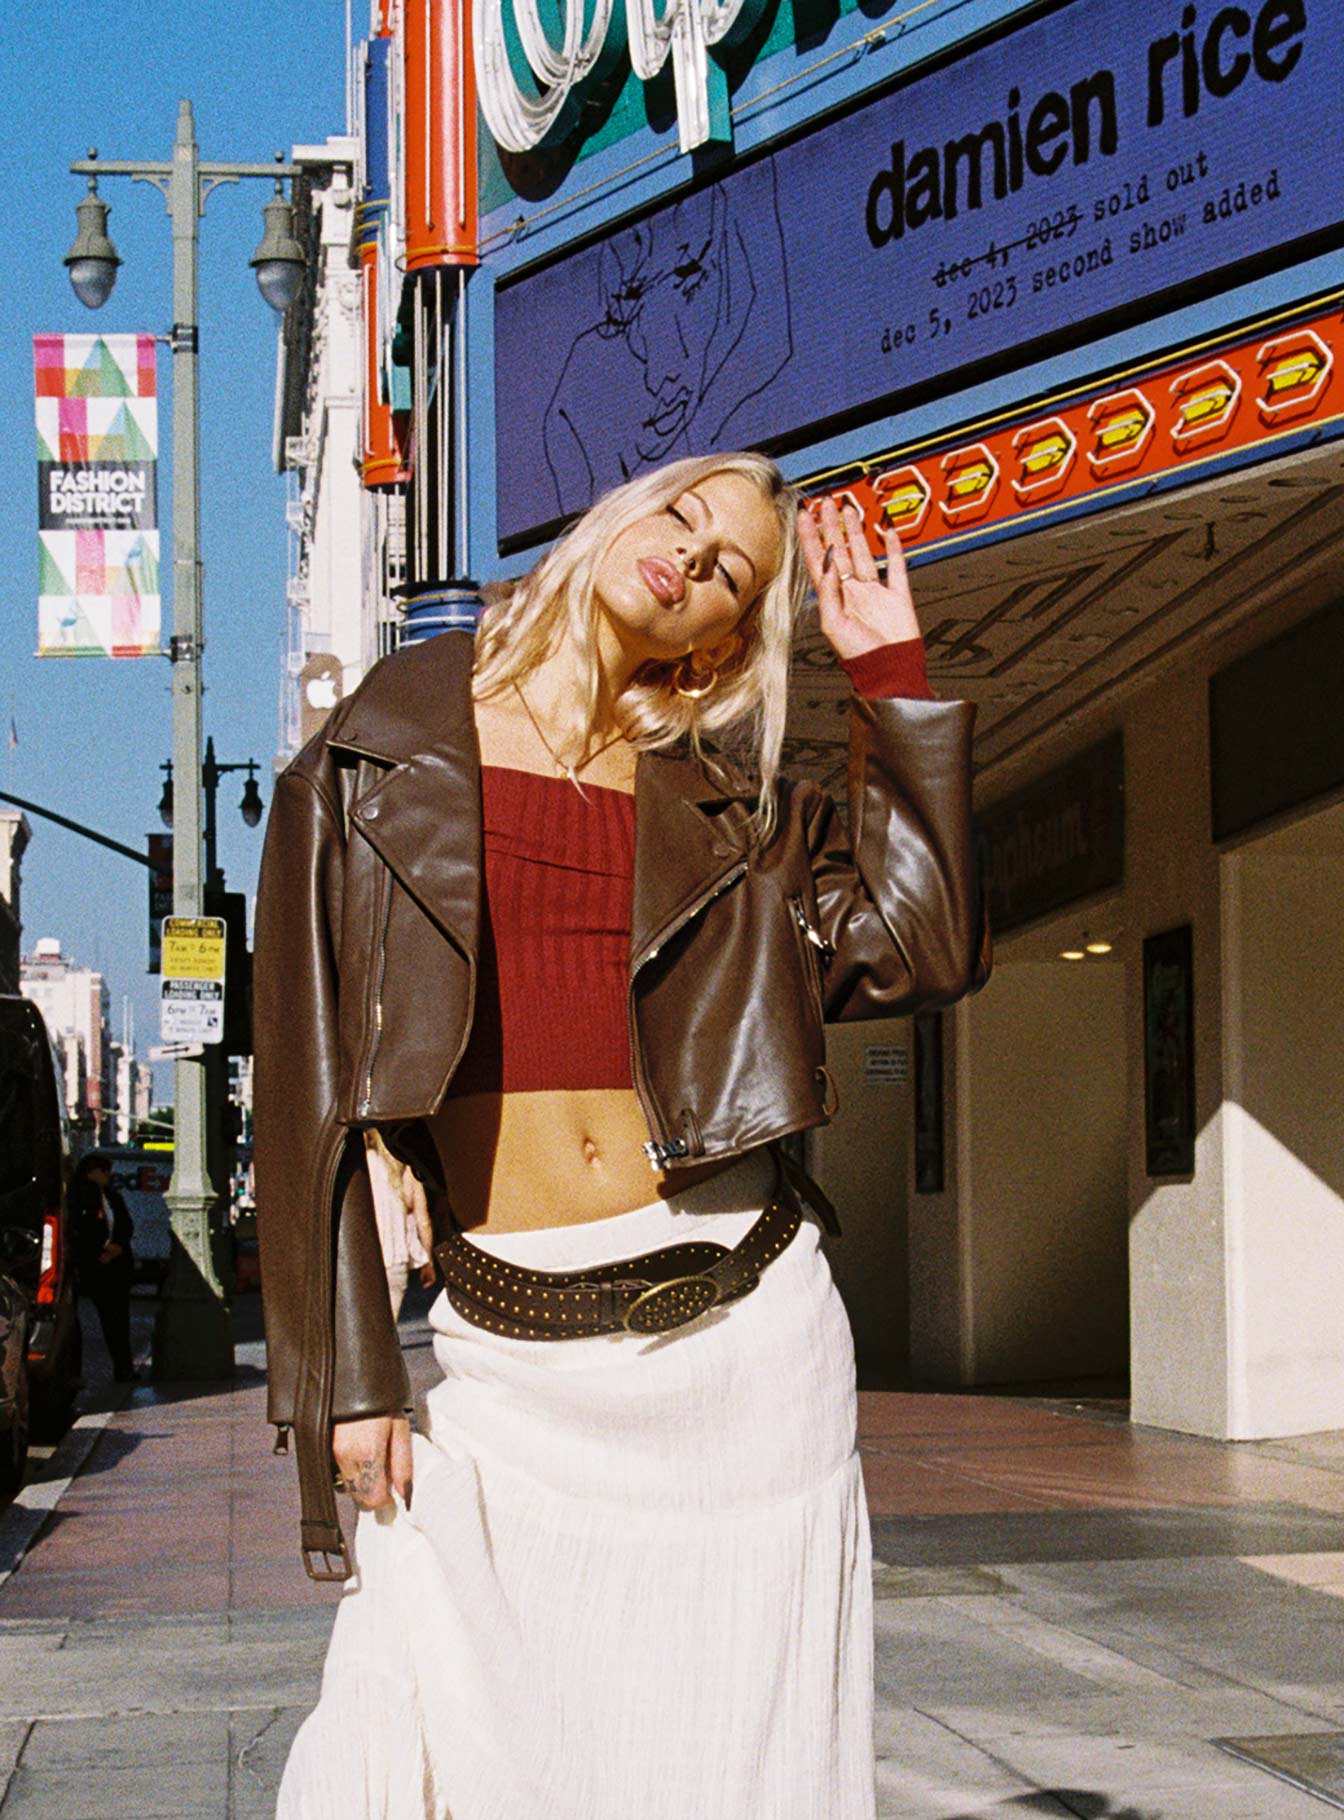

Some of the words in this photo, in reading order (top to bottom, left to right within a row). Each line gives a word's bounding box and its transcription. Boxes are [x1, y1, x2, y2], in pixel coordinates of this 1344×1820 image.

[865, 70, 1118, 249] damien
[1146, 0, 1307, 128] rice
[1026, 204, 1083, 251] 2023
[1094, 175, 1150, 222] sold
[1166, 154, 1209, 192] out
[880, 323, 916, 354] dec
[929, 308, 953, 338] 5,
[967, 275, 1018, 319] 2023
[1032, 240, 1113, 293] second
[1129, 213, 1187, 254] show
[1202, 169, 1281, 224] added
[49, 470, 146, 492] FASHION
[49, 492, 145, 513] DISTRICT
